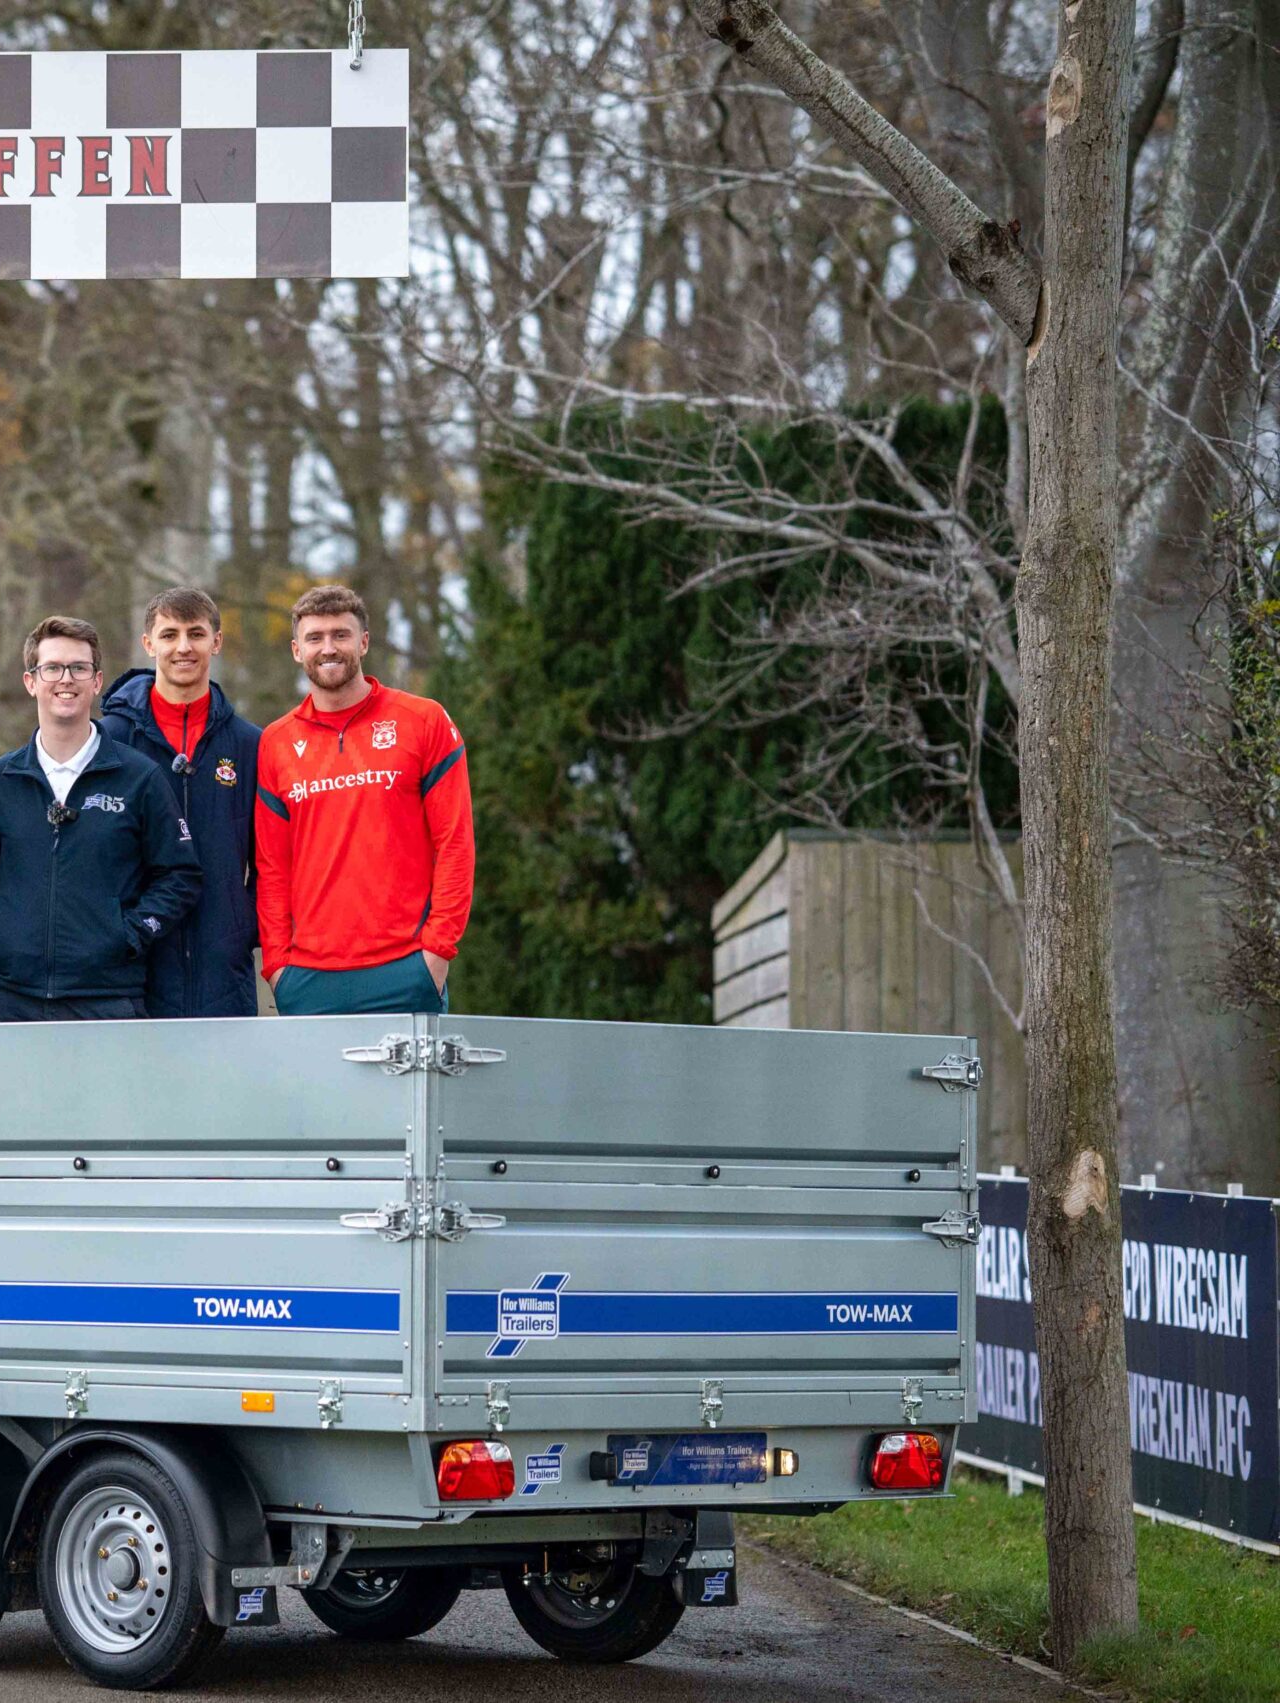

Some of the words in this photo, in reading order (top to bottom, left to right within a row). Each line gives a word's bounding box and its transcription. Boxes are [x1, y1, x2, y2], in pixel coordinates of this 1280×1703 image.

[309, 768, 401, 793] ancestry
[100, 795, 126, 813] 65
[1122, 1238, 1151, 1322] CPD
[1153, 1243, 1248, 1340] WRECSAM
[193, 1297, 292, 1320] TOW-MAX
[502, 1297, 518, 1311] Ifor
[518, 1297, 555, 1312] Williams
[825, 1304, 913, 1324] TOW-MAX
[503, 1315, 555, 1332] Trailers
[1215, 1391, 1252, 1482] AFC
[695, 1446, 725, 1456] Williams
[727, 1445, 753, 1455] Trailers
[529, 1470, 559, 1479] Trailers
